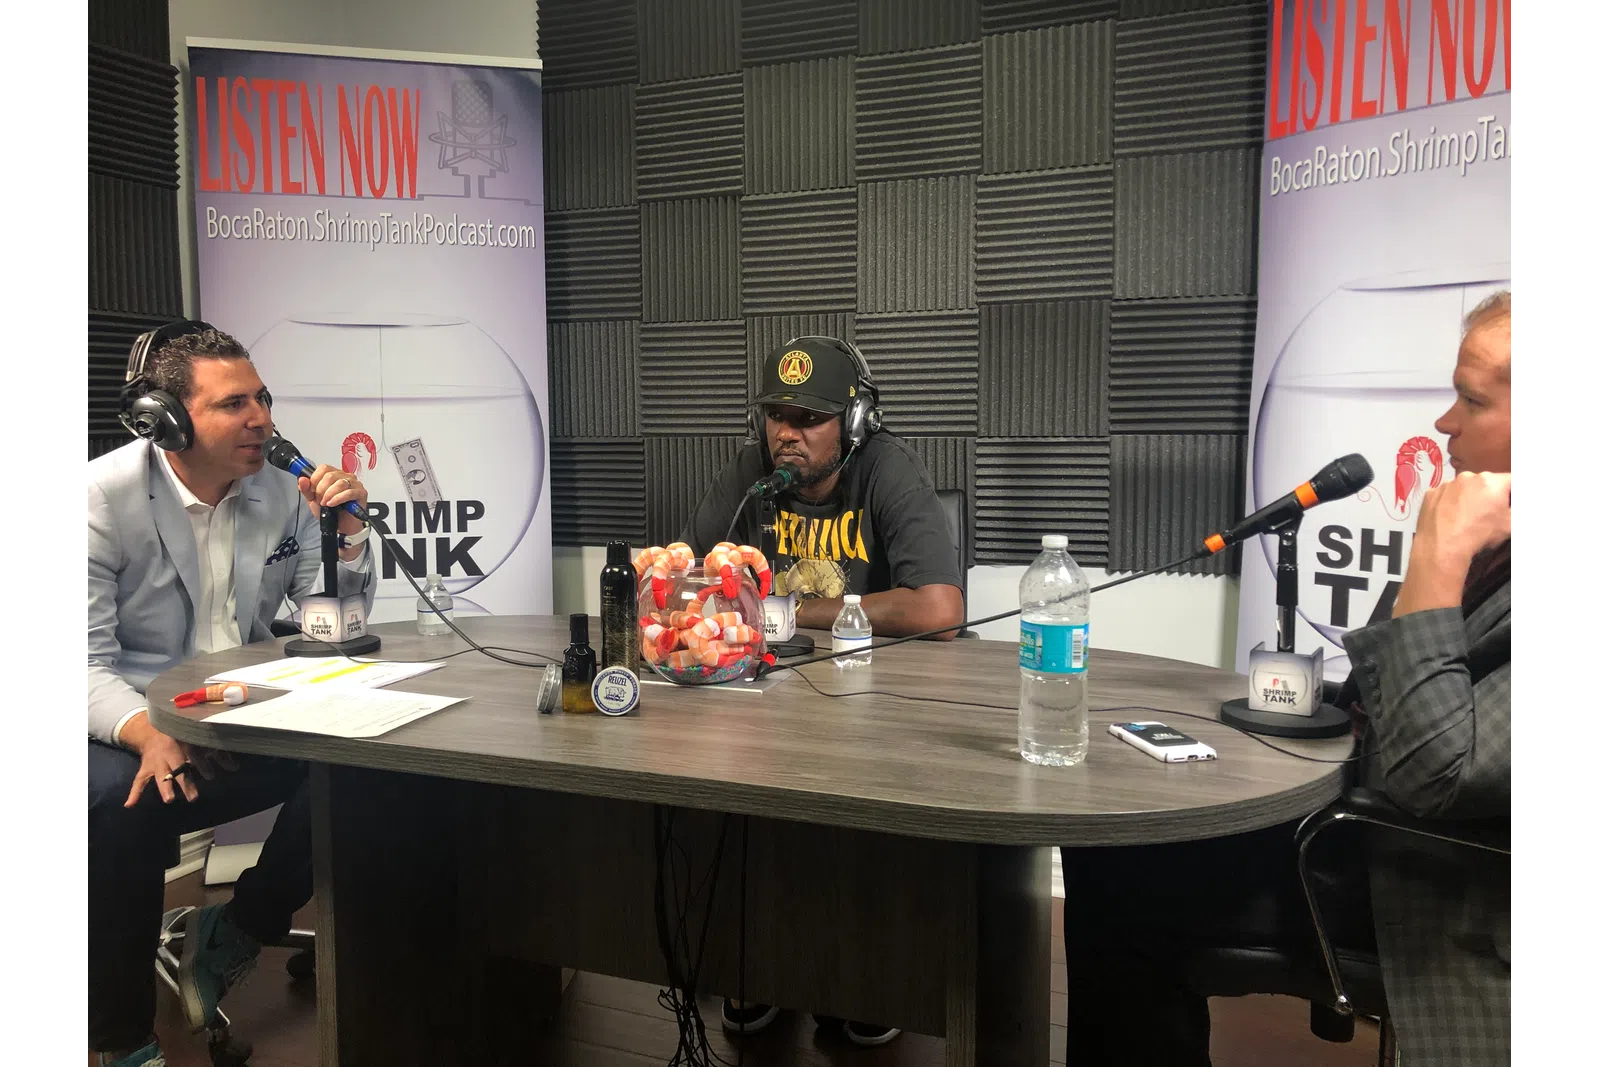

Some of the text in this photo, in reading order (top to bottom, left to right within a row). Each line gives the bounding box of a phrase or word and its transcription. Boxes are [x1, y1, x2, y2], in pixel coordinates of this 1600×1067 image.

[1269, 0, 1512, 140] LISTEN NO
[196, 76, 421, 199] LISTEN NOW
[206, 206, 536, 251] BocaRaton.ShrimpTankPodcast.com
[366, 500, 485, 534] RIMP
[772, 508, 870, 564] ETALLICA
[382, 536, 486, 579] NK
[1316, 524, 1418, 576] SH
[608, 676, 627, 686] REUZEL
[1263, 688, 1297, 697] SHRIMP
[1263, 695, 1297, 705] TANK
